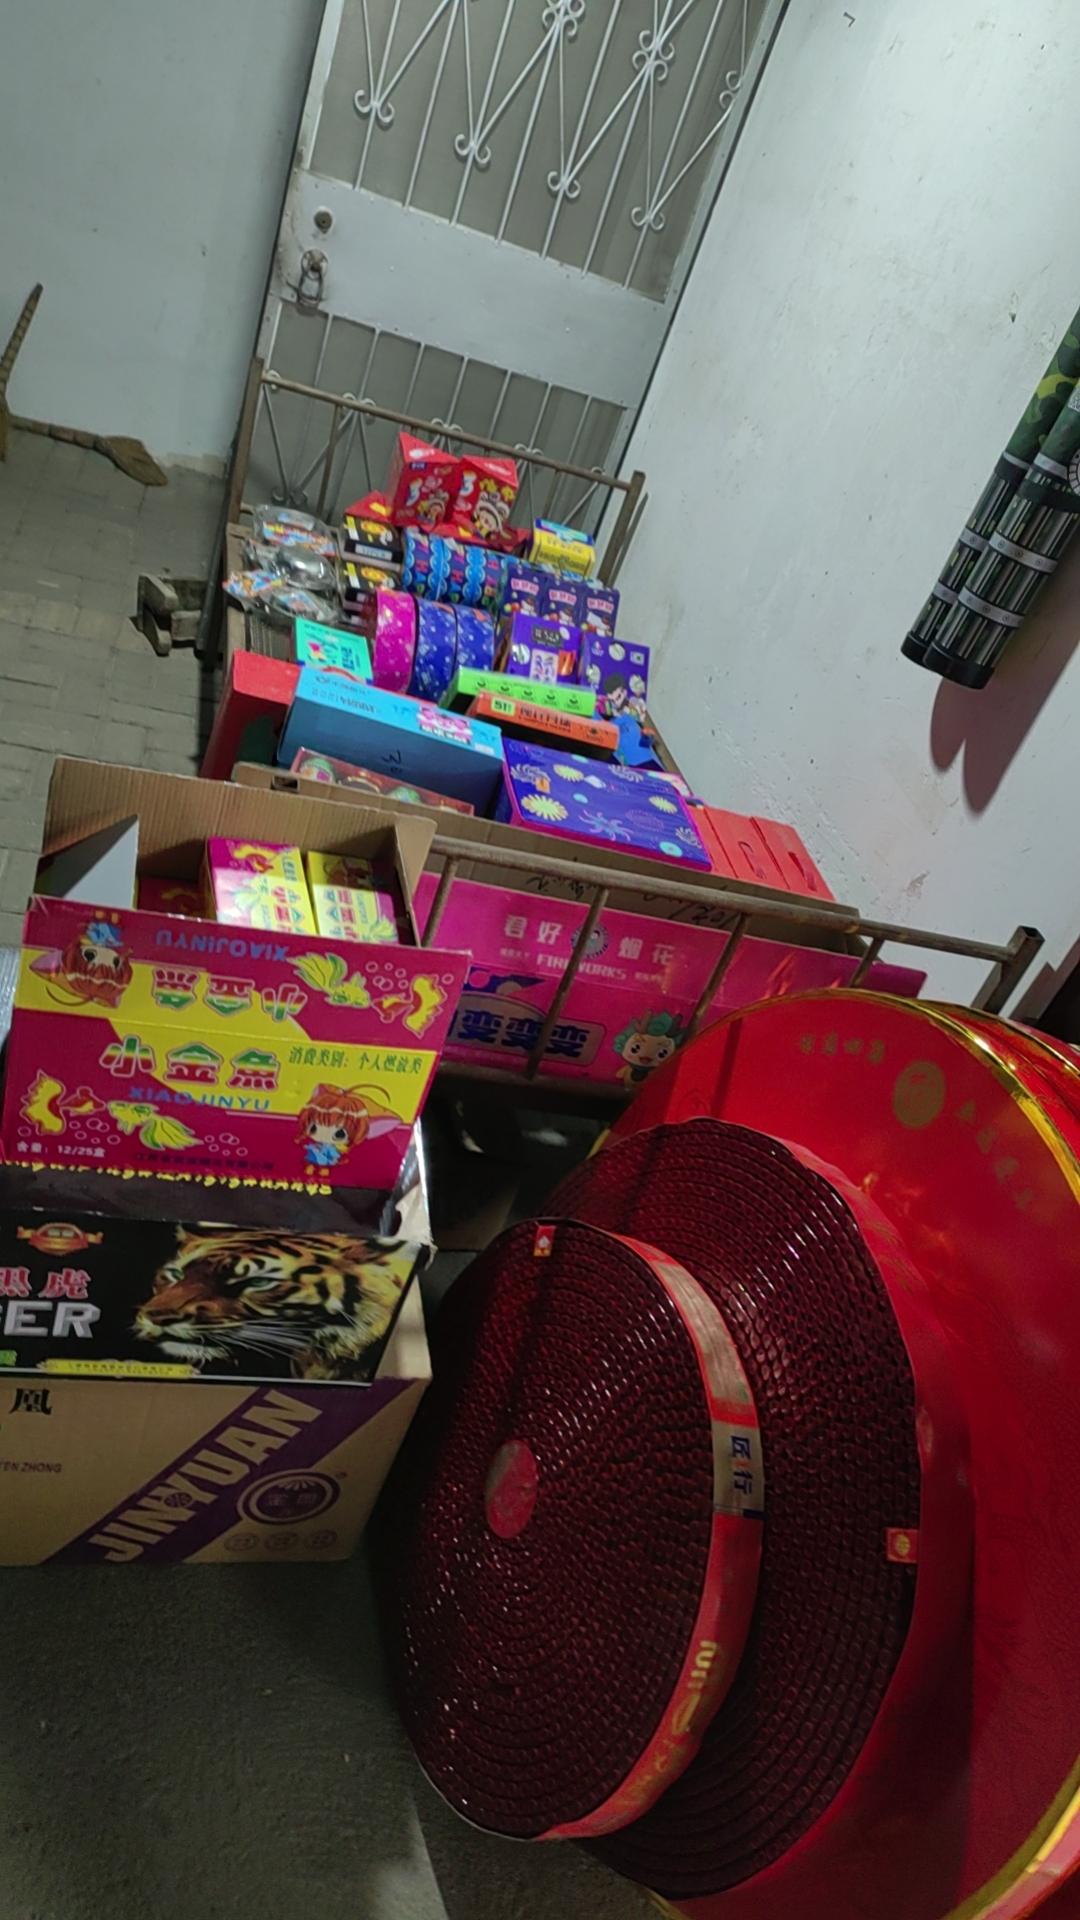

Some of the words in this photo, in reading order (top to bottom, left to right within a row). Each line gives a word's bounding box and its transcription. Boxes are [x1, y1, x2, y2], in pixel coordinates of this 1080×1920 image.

[155, 928, 290, 962] XIAOJINYU
[128, 1086, 271, 1112] XIAOJINYU
[0, 1300, 102, 1338] ER
[88, 1389, 323, 1563] JINYUAN
